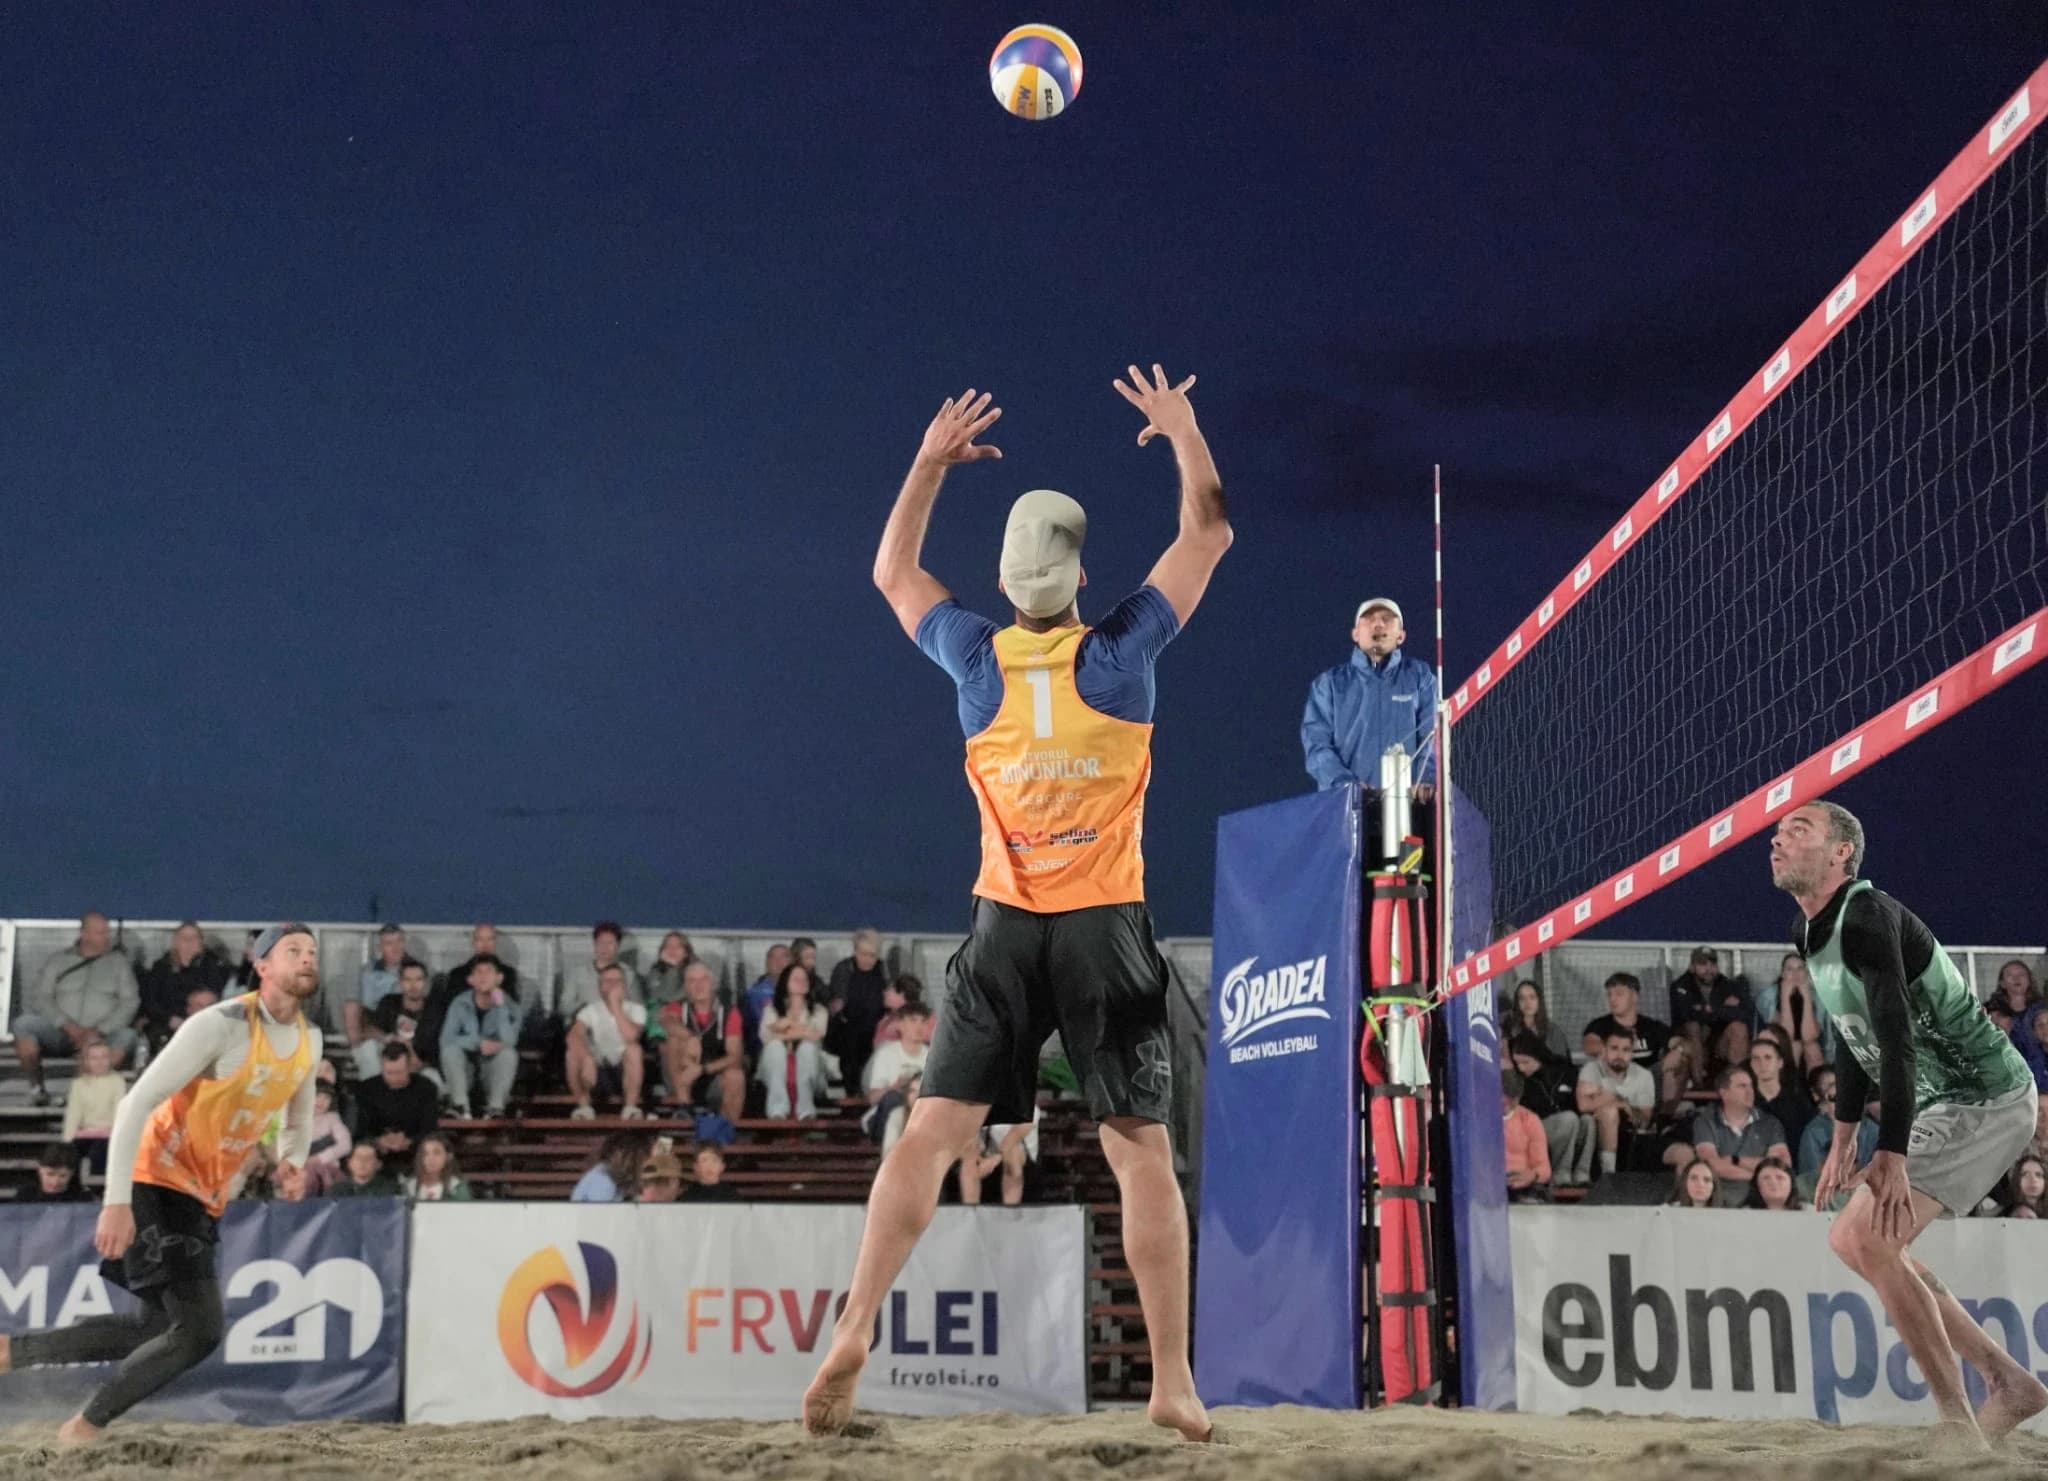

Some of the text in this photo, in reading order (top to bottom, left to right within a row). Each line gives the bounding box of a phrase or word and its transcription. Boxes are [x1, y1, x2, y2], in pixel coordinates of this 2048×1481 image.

[1024, 668, 1054, 738] 1
[1220, 955, 1328, 1044] ORADEA
[1230, 1034, 1318, 1065] BEACH VOLLEYBALL
[890, 1367, 1000, 1388] frvolei.ro
